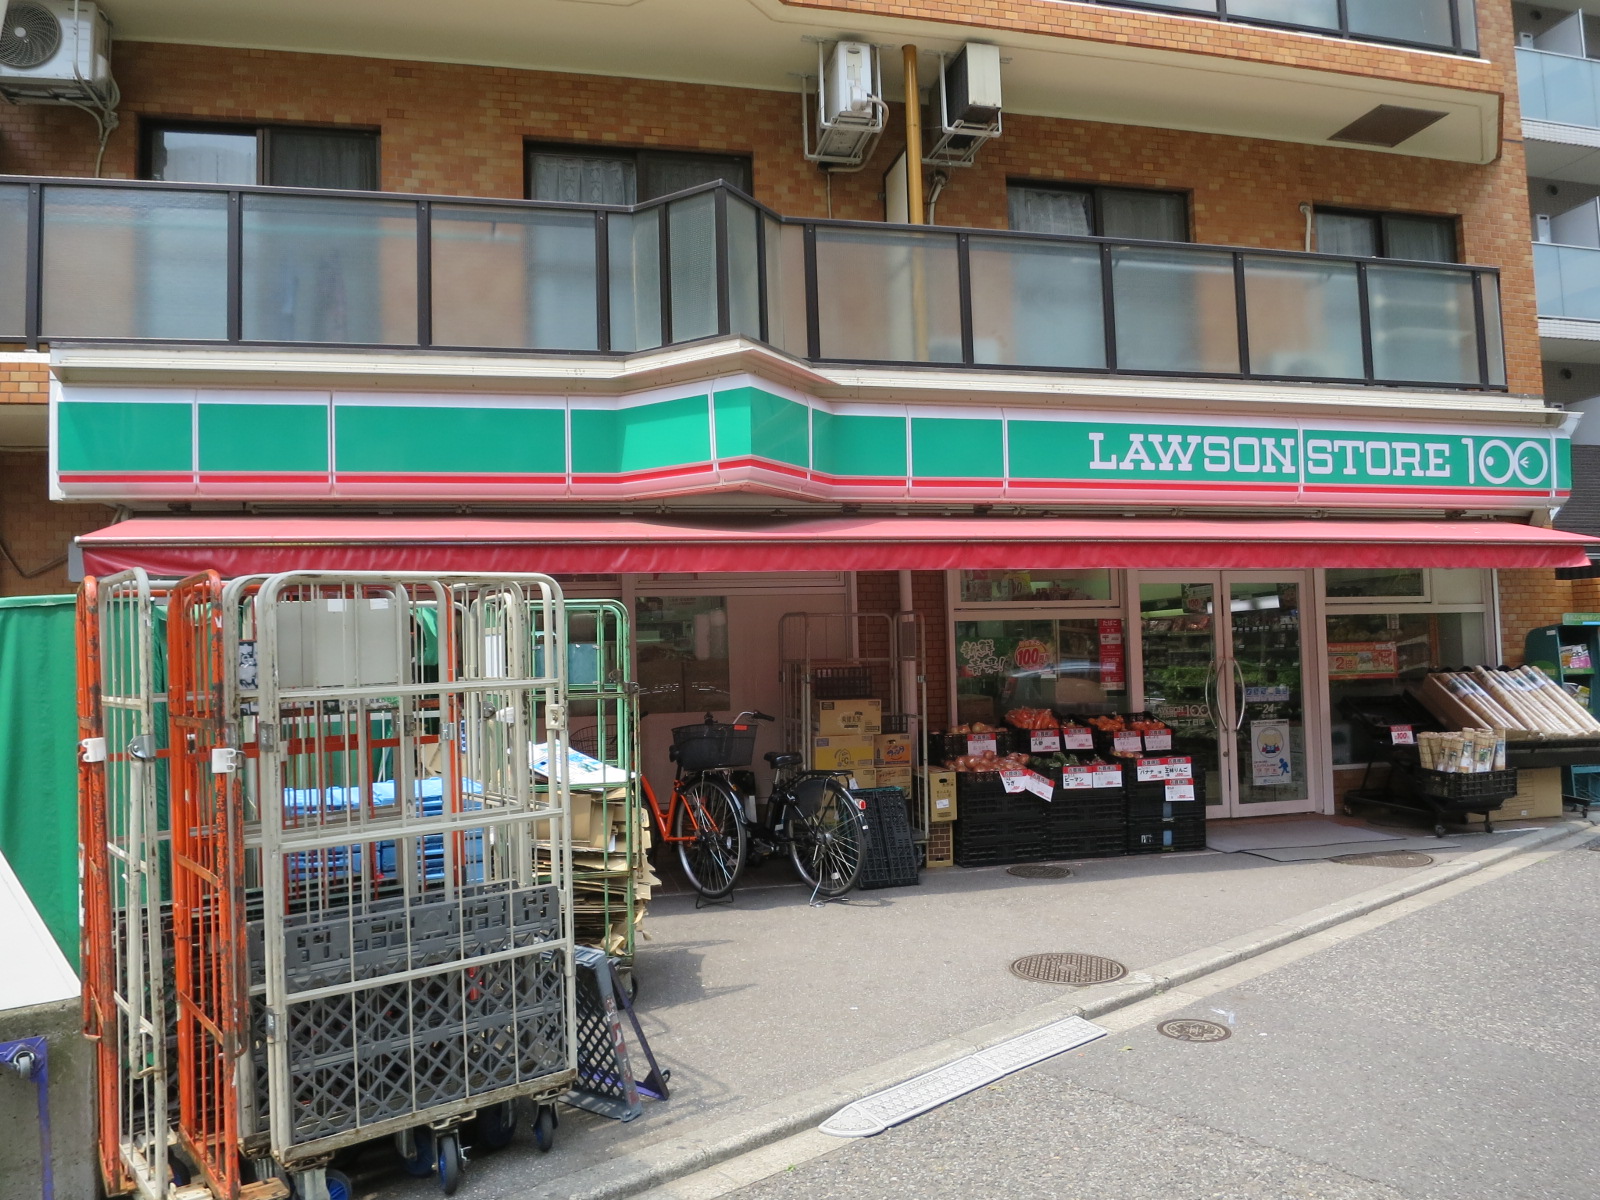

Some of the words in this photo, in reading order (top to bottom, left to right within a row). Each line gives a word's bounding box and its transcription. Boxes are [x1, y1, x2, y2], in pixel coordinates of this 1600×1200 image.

[1088, 432, 1296, 474] LAWSON
[1307, 439, 1451, 478] STORE
[1461, 437, 1549, 486] 100
[960, 639, 995, 659] 新鮮
[1185, 704, 1209, 717] 100
